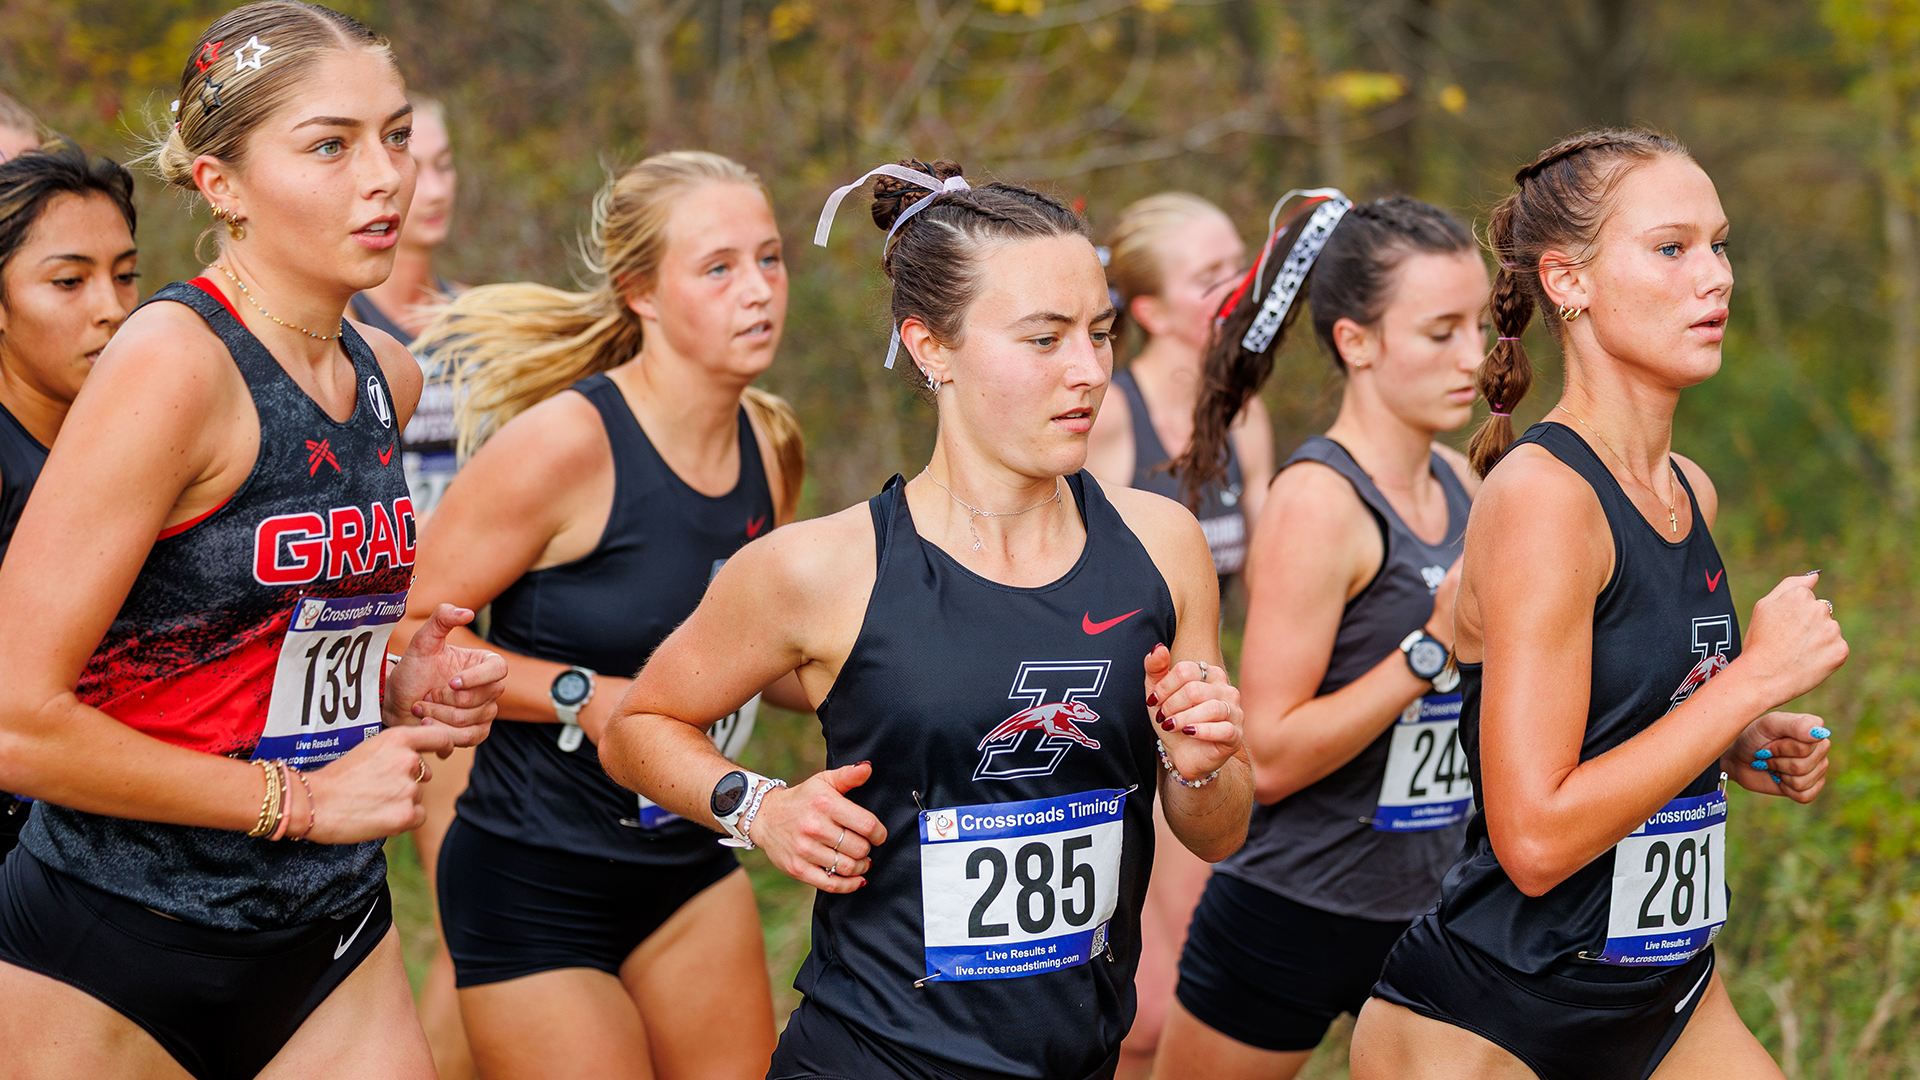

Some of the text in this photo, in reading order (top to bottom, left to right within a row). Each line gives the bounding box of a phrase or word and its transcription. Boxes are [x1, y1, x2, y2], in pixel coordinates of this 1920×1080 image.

[321, 601, 405, 621] Crossroads Timing
[301, 631, 373, 726] 139
[295, 737, 339, 750] Live Results at
[961, 798, 1119, 831] Crossroads Timing
[1706, 799, 1726, 817] Timing
[965, 834, 1096, 939] 285
[1637, 833, 1711, 931] 281
[986, 944, 1057, 961] Live Results at
[1645, 937, 1691, 950] Live Results at
[955, 953, 1079, 976] live.crossroadstiming.com
